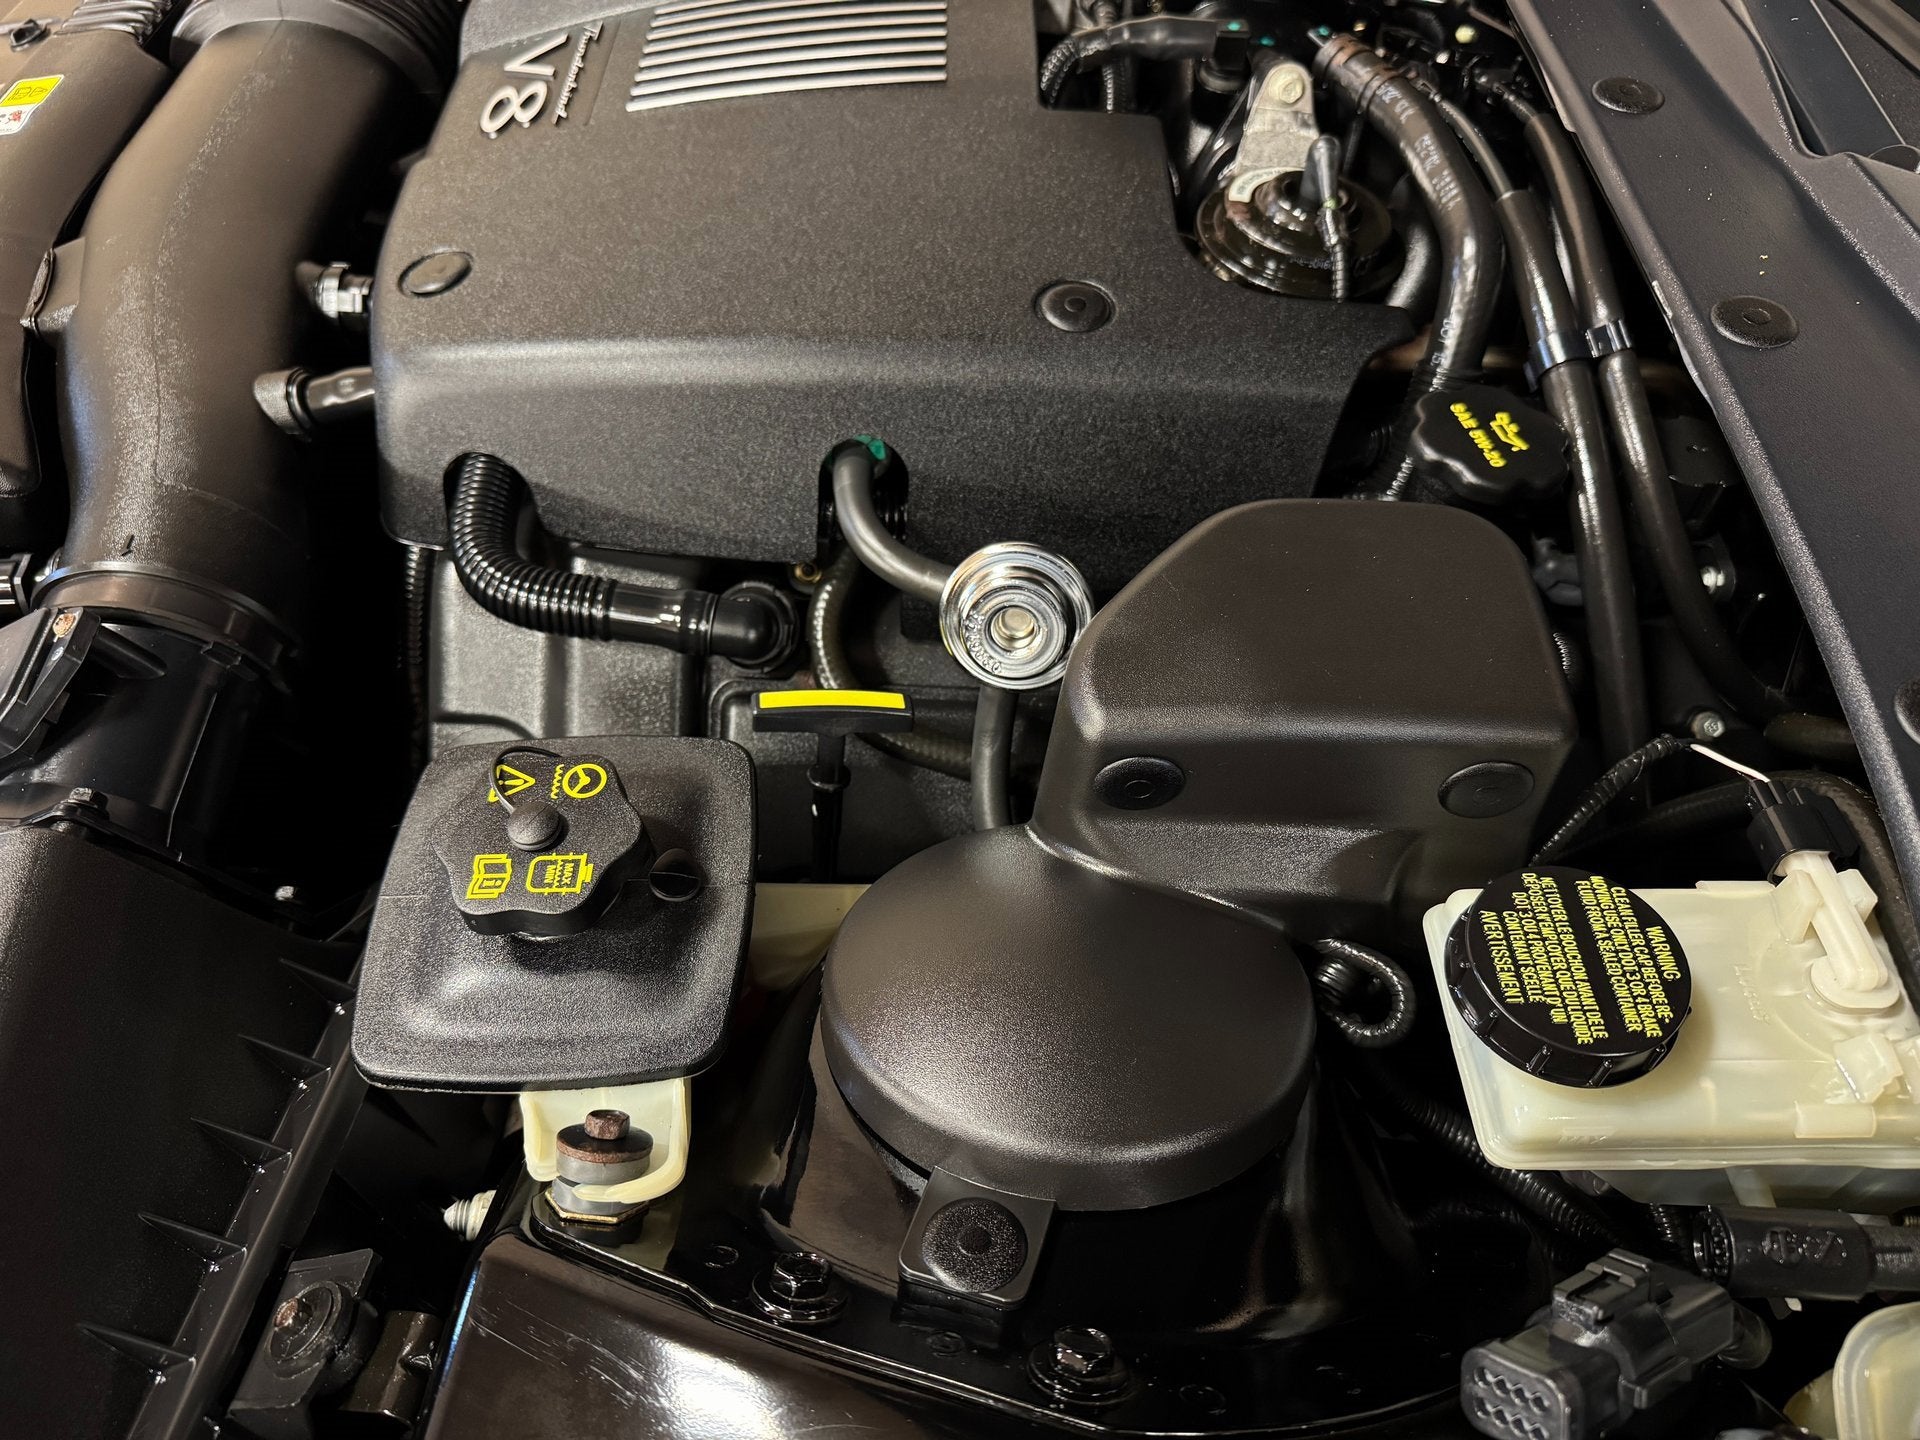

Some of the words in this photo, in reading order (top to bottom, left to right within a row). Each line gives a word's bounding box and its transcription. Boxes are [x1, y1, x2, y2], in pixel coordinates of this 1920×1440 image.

[480, 33, 569, 135] V8
[552, 20, 604, 125] Thunderbird
[1450, 402, 1479, 429] SAE
[1468, 428, 1507, 468] 5W-20
[544, 864, 556, 883] MIN
[561, 862, 574, 884] MAX
[1512, 892, 1531, 909] DOT
[1540, 877, 1567, 921] NETTOYER
[1575, 880, 1596, 905] FLUID
[1590, 876, 1614, 909] MOVING
[1611, 886, 1633, 915] CLEAN
[1518, 910, 1533, 918] 3
[1521, 918, 1538, 932] OU
[1555, 921, 1572, 933] LE
[1585, 906, 1606, 931] FROM
[1603, 910, 1622, 927] USE
[1503, 911, 1533, 964] CONTENANT
[1536, 913, 1567, 969] N'EMPLOYER
[1610, 928, 1630, 951] ONLY
[1622, 916, 1645, 945] FILLER
[1480, 911, 1523, 1003] AVERTISSEMENT
[1560, 934, 1587, 979] BOUCHON
[1597, 940, 1622, 975] SEALED
[1618, 952, 1638, 971] DOT
[1633, 946, 1653, 966] CAP
[1646, 926, 1680, 979] WARNING
[1528, 940, 1559, 995] PROVENANT
[1556, 970, 1575, 990] QUE
[1626, 972, 1641, 980] 3
[1562, 991, 1580, 1005] DU
[1575, 980, 1598, 1010] AVANT
[1629, 981, 1646, 996] OR
[1641, 967, 1667, 1004] BEFORE
[1611, 976, 1642, 1031] CONTAINER
[1655, 1005, 1673, 1023] RE-
[1567, 1005, 1593, 1044] LIQUIDE
[1585, 1011, 1604, 1025] DE
[1590, 1025, 1608, 1038] LE
[1637, 1004, 1662, 1037] BRAKE
